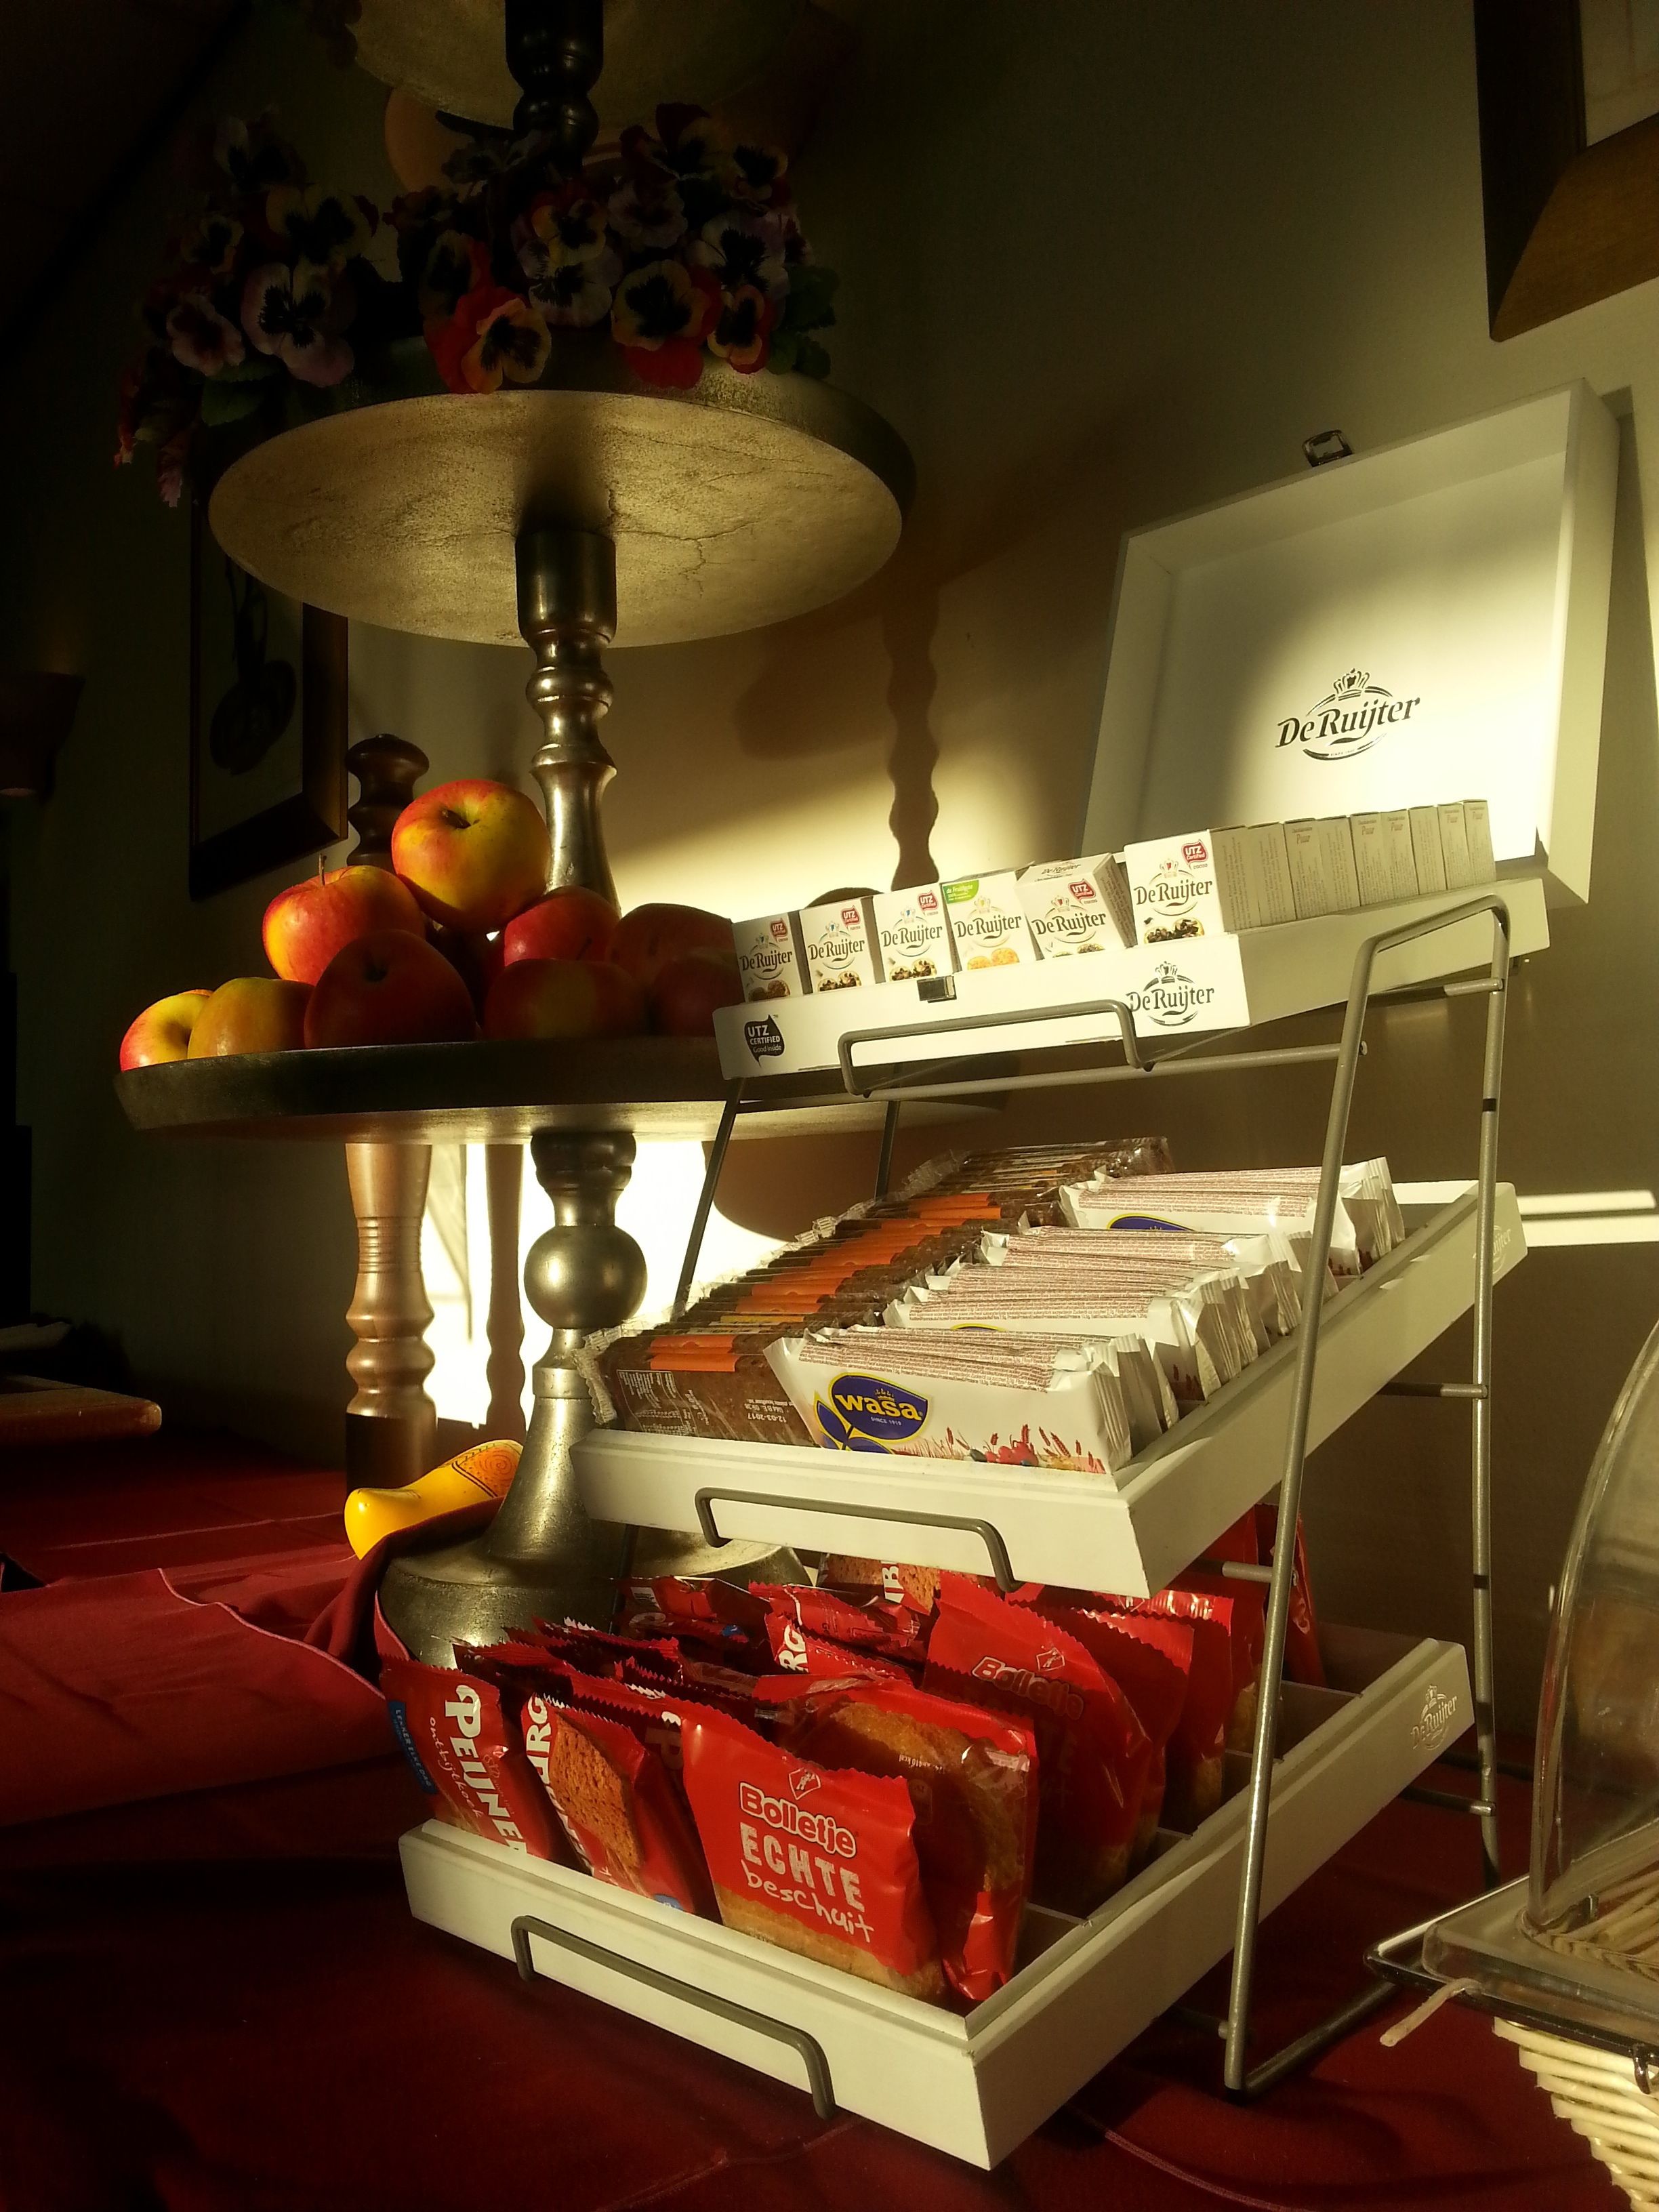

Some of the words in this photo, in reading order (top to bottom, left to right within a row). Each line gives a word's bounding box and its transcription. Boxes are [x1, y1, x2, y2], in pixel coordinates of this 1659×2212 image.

[1275, 717, 1315, 748] De
[1315, 697, 1420, 746] Ruijter
[1185, 845, 1202, 855] UTZ
[920, 895, 933, 904] UTZ
[1071, 884, 1088, 893] UTZ
[1133, 886, 1155, 905] De
[1155, 879, 1212, 907] Ruijter
[773, 923, 784, 931] UTZ
[843, 911, 855, 919] UTZ
[954, 920, 974, 937] De
[972, 914, 1021, 940] Ruijter
[1031, 919, 1054, 935] De
[1052, 912, 1106, 937] Ruijter
[881, 930, 898, 947] De
[898, 924, 943, 949] Ruijter
[739, 955, 755, 970] De
[754, 949, 792, 973] Ruijter
[808, 944, 824, 960] De
[823, 938, 865, 962] Ruijter
[1126, 991, 1151, 1012] De
[1151, 985, 1214, 1016] Ruijter
[747, 1025, 769, 1037] UTZ
[750, 1036, 780, 1045] CERTIFIED
[747, 1412, 787, 1423] 12-03-2017
[835, 1394, 922, 1421] wasa
[889, 1418, 902, 1426] 1919
[1424, 1695, 1458, 1740] Ruijter
[739, 1782, 857, 1858] Bolletje
[739, 1822, 865, 1912] ECHTE
[741, 1859, 874, 1943] beschuit
